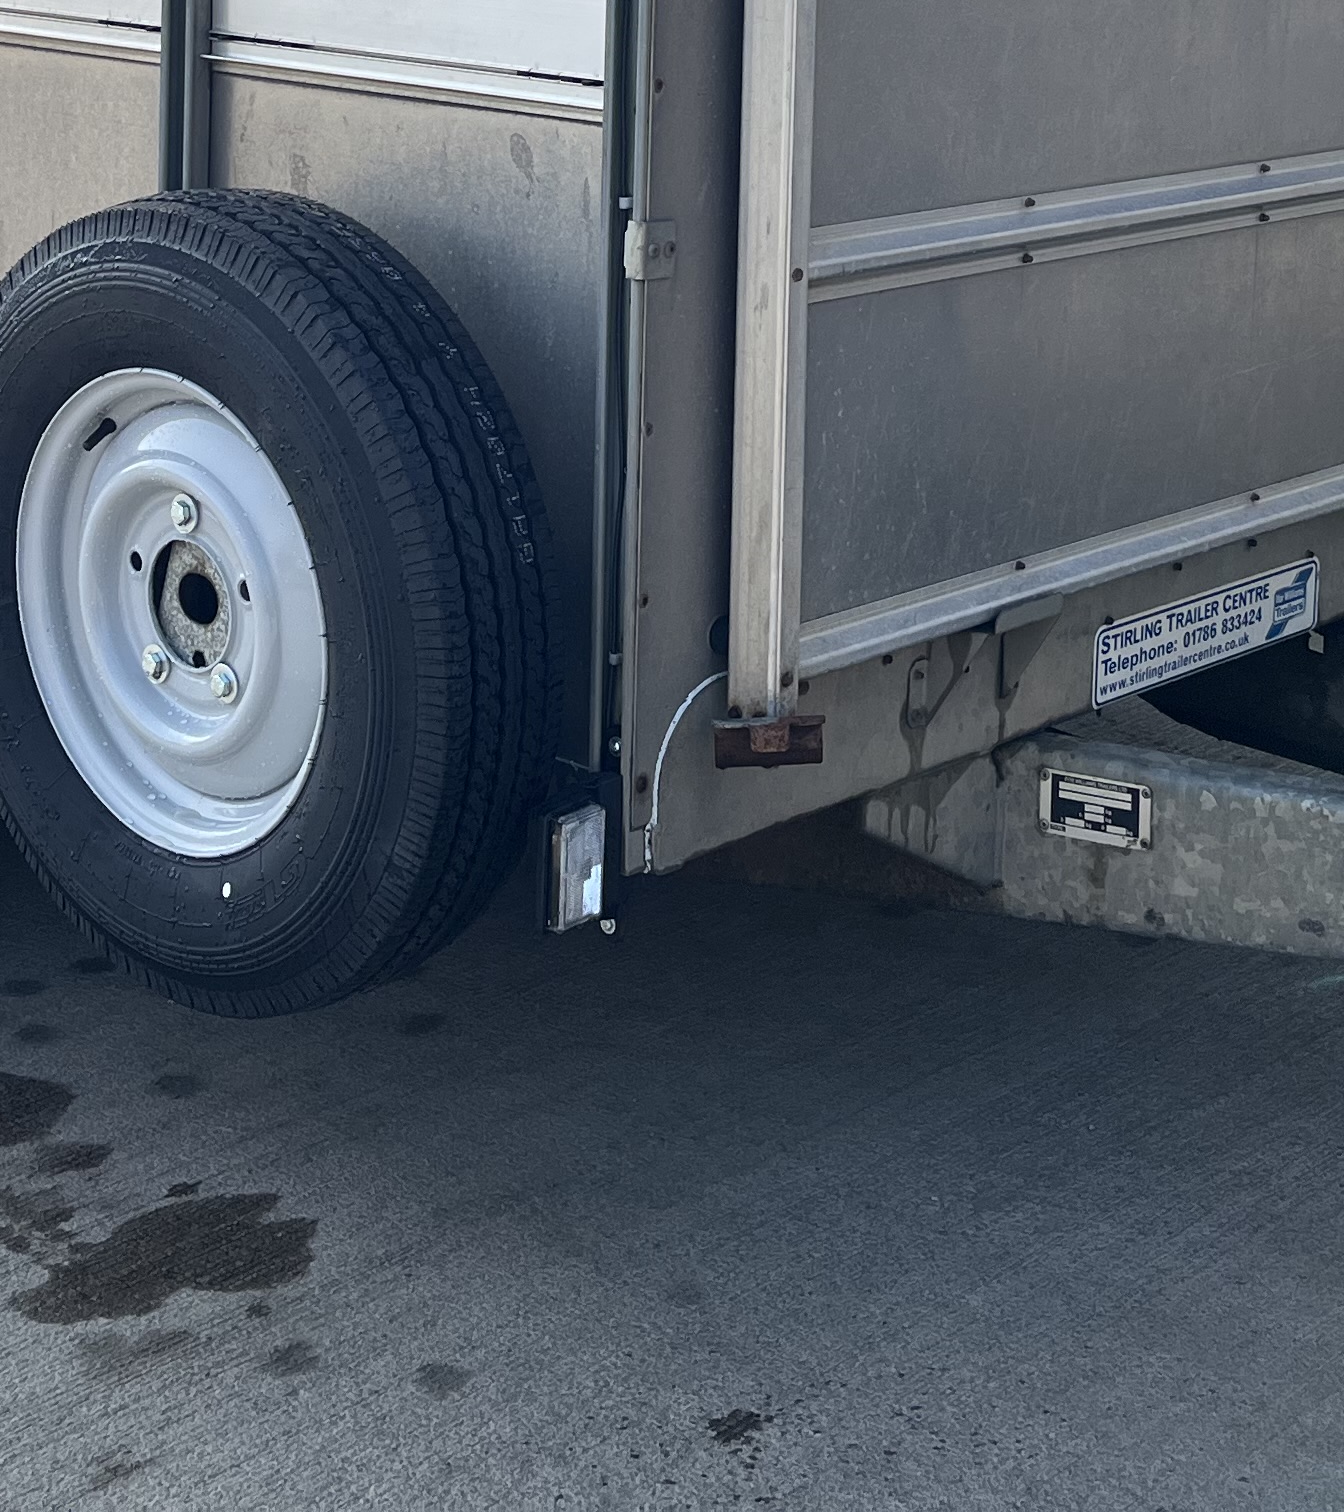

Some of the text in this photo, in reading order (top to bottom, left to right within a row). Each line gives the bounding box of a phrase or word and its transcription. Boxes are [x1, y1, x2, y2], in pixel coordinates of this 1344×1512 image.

[1101, 582, 1270, 655] STIRLING TRAILER CENTRE
[1101, 606, 1263, 676] Telephone: 01786 833424
[1099, 632, 1250, 696] www.stirlingtrailercentre.co.uk
